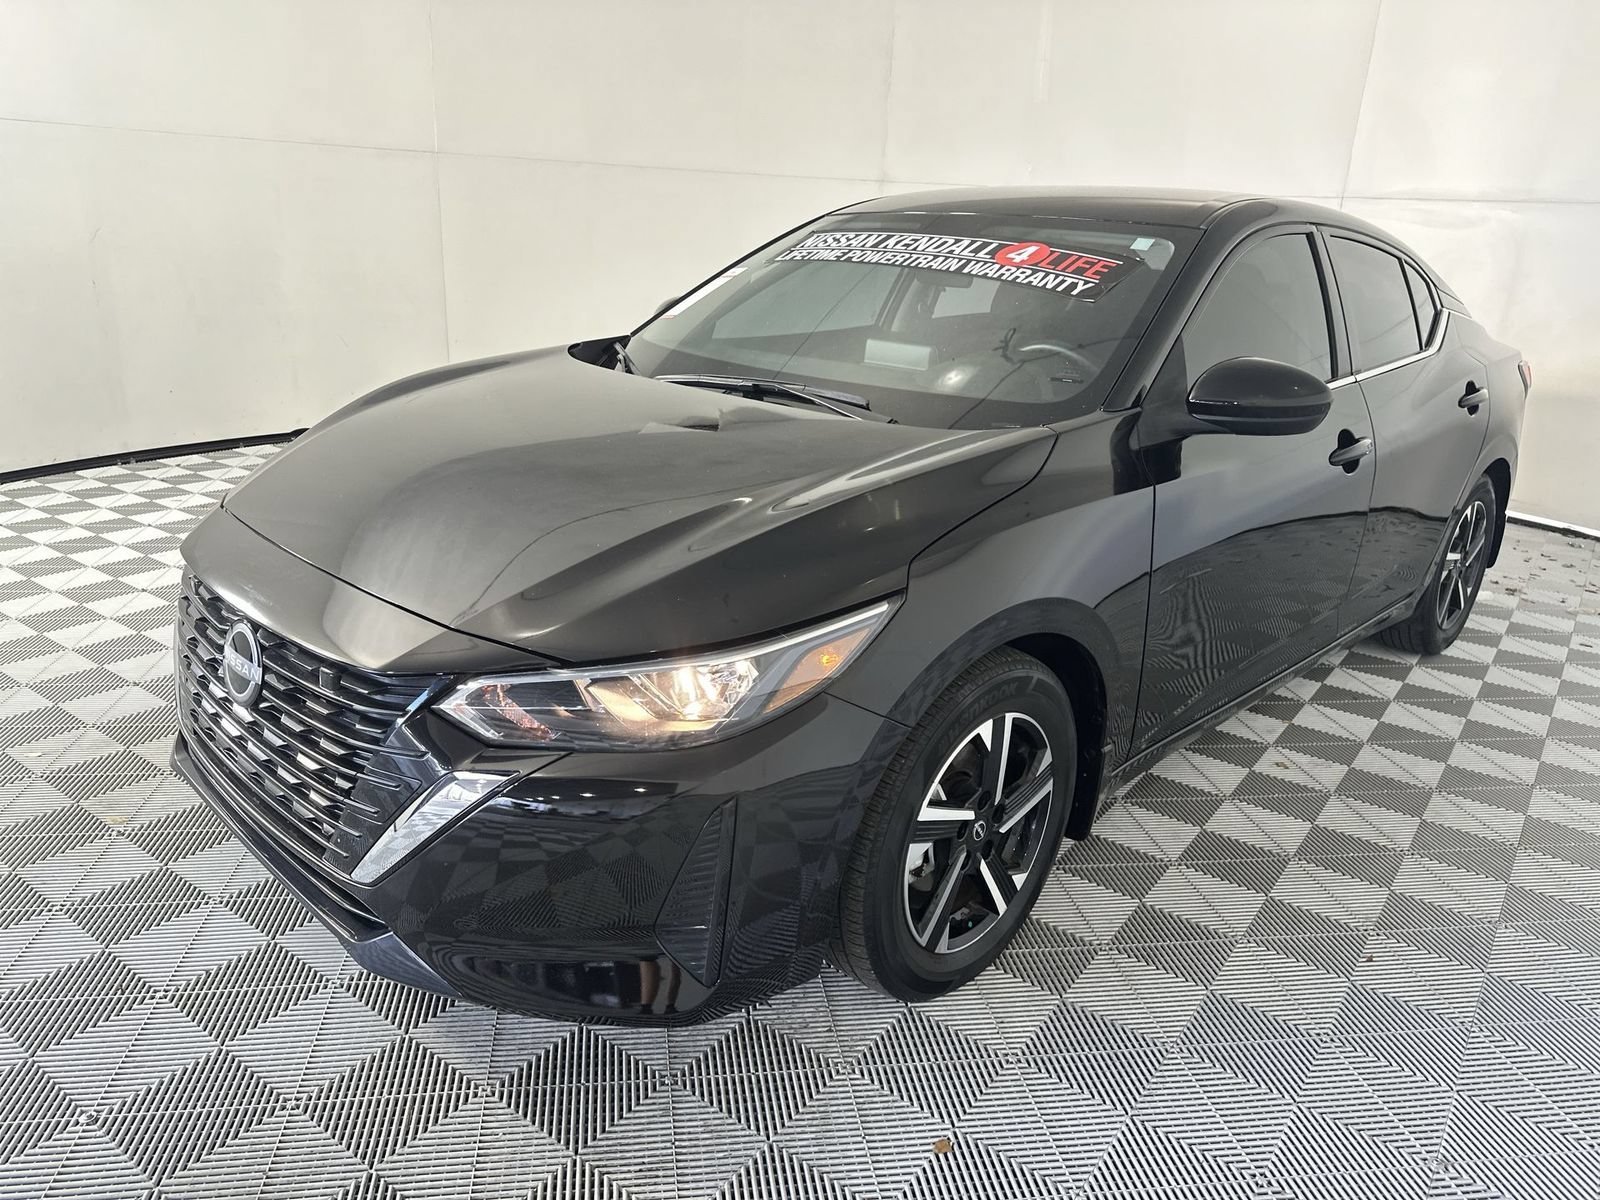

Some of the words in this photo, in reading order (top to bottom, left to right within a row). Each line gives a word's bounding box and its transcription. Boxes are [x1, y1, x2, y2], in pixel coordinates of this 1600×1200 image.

[775, 249, 850, 262] LIFETIME
[841, 251, 963, 272] POWERTRAIN
[962, 261, 1095, 296] WARRANTY
[797, 233, 879, 249] NISSAN
[880, 235, 1000, 259] KENDALL
[1005, 245, 1040, 263] 4
[1039, 252, 1117, 280] LIFE
